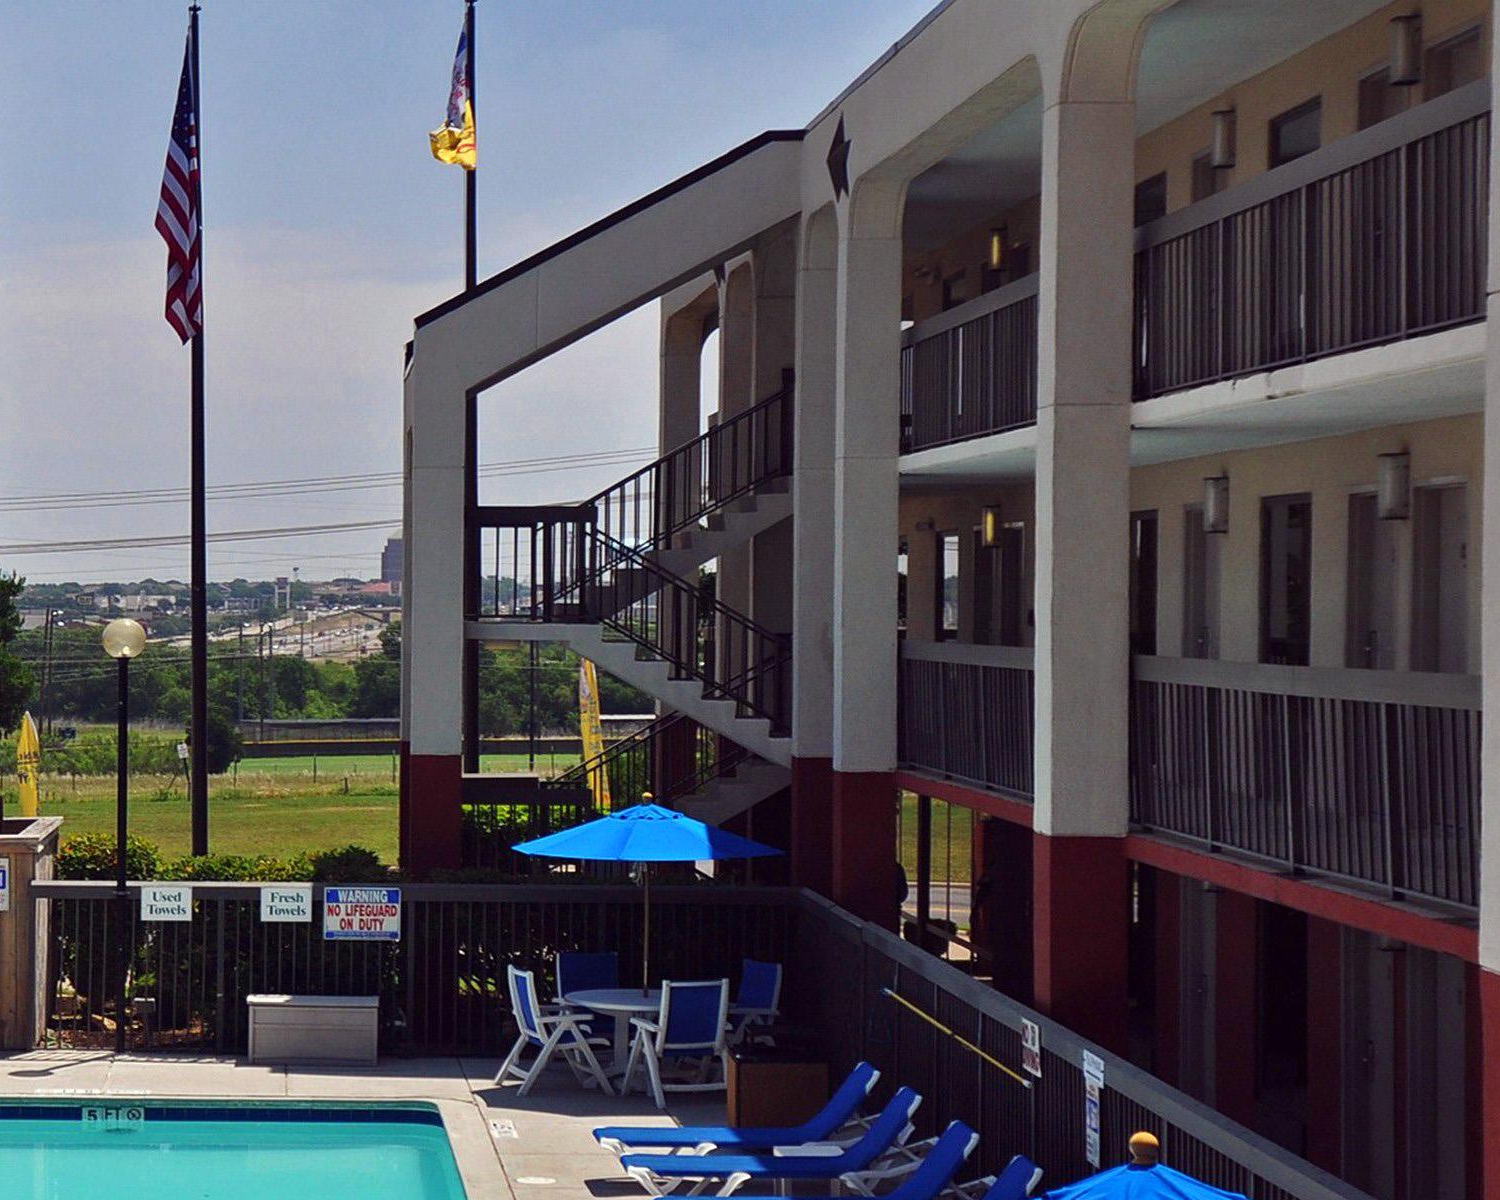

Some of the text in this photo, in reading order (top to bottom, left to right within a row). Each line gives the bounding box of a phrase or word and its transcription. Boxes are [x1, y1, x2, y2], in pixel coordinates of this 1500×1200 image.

[152, 891, 182, 902] Used
[270, 892, 304, 903] Fresh
[338, 890, 388, 903] WARNING
[146, 904, 187, 915] Towels
[266, 904, 307, 916] Towels
[327, 904, 398, 917] NO LIFEGUARD
[339, 918, 385, 930] ON DUTY
[87, 1108, 120, 1121] 5 FT
